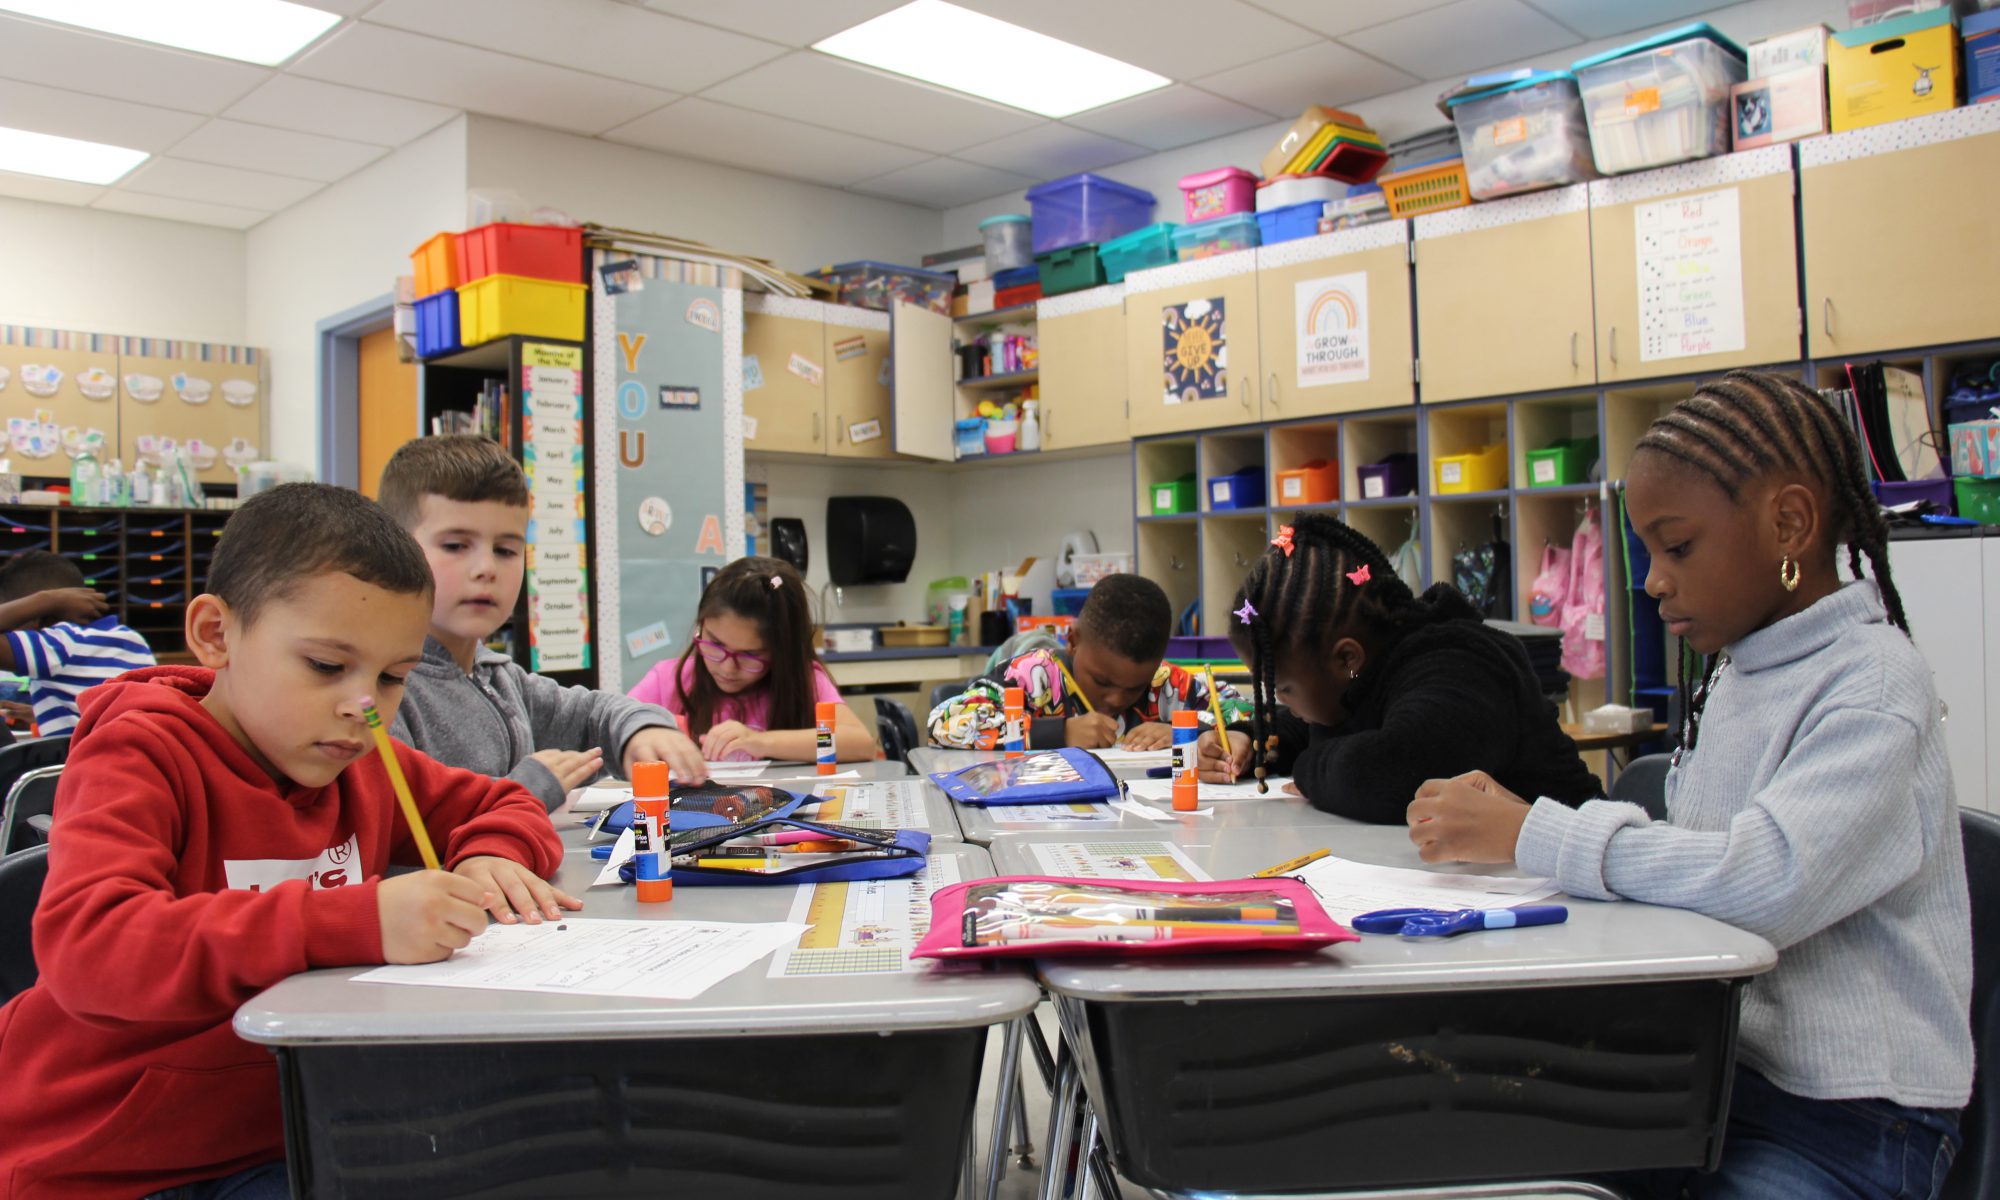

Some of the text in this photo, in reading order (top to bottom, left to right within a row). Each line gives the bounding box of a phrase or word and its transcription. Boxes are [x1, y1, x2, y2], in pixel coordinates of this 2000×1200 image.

[1681, 202, 1703, 219] Red
[1680, 289, 1713, 302] Green
[1684, 312, 1709, 327] Blue
[1314, 335, 1348, 350] GROW
[1681, 336, 1713, 353] Purple
[1180, 343, 1207, 357] GIVE
[1306, 347, 1359, 363] THROUGH
[537, 358, 571, 367] the Year
[1186, 355, 1200, 369] UP
[538, 376, 569, 386] January
[536, 400, 571, 411] February
[546, 451, 564, 459] April
[547, 476, 563, 485] May
[548, 527, 564, 536] July
[544, 552, 570, 562] August
[537, 577, 578, 587] September
[544, 603, 574, 611] October
[541, 627, 579, 636] November
[542, 653, 579, 661] December
